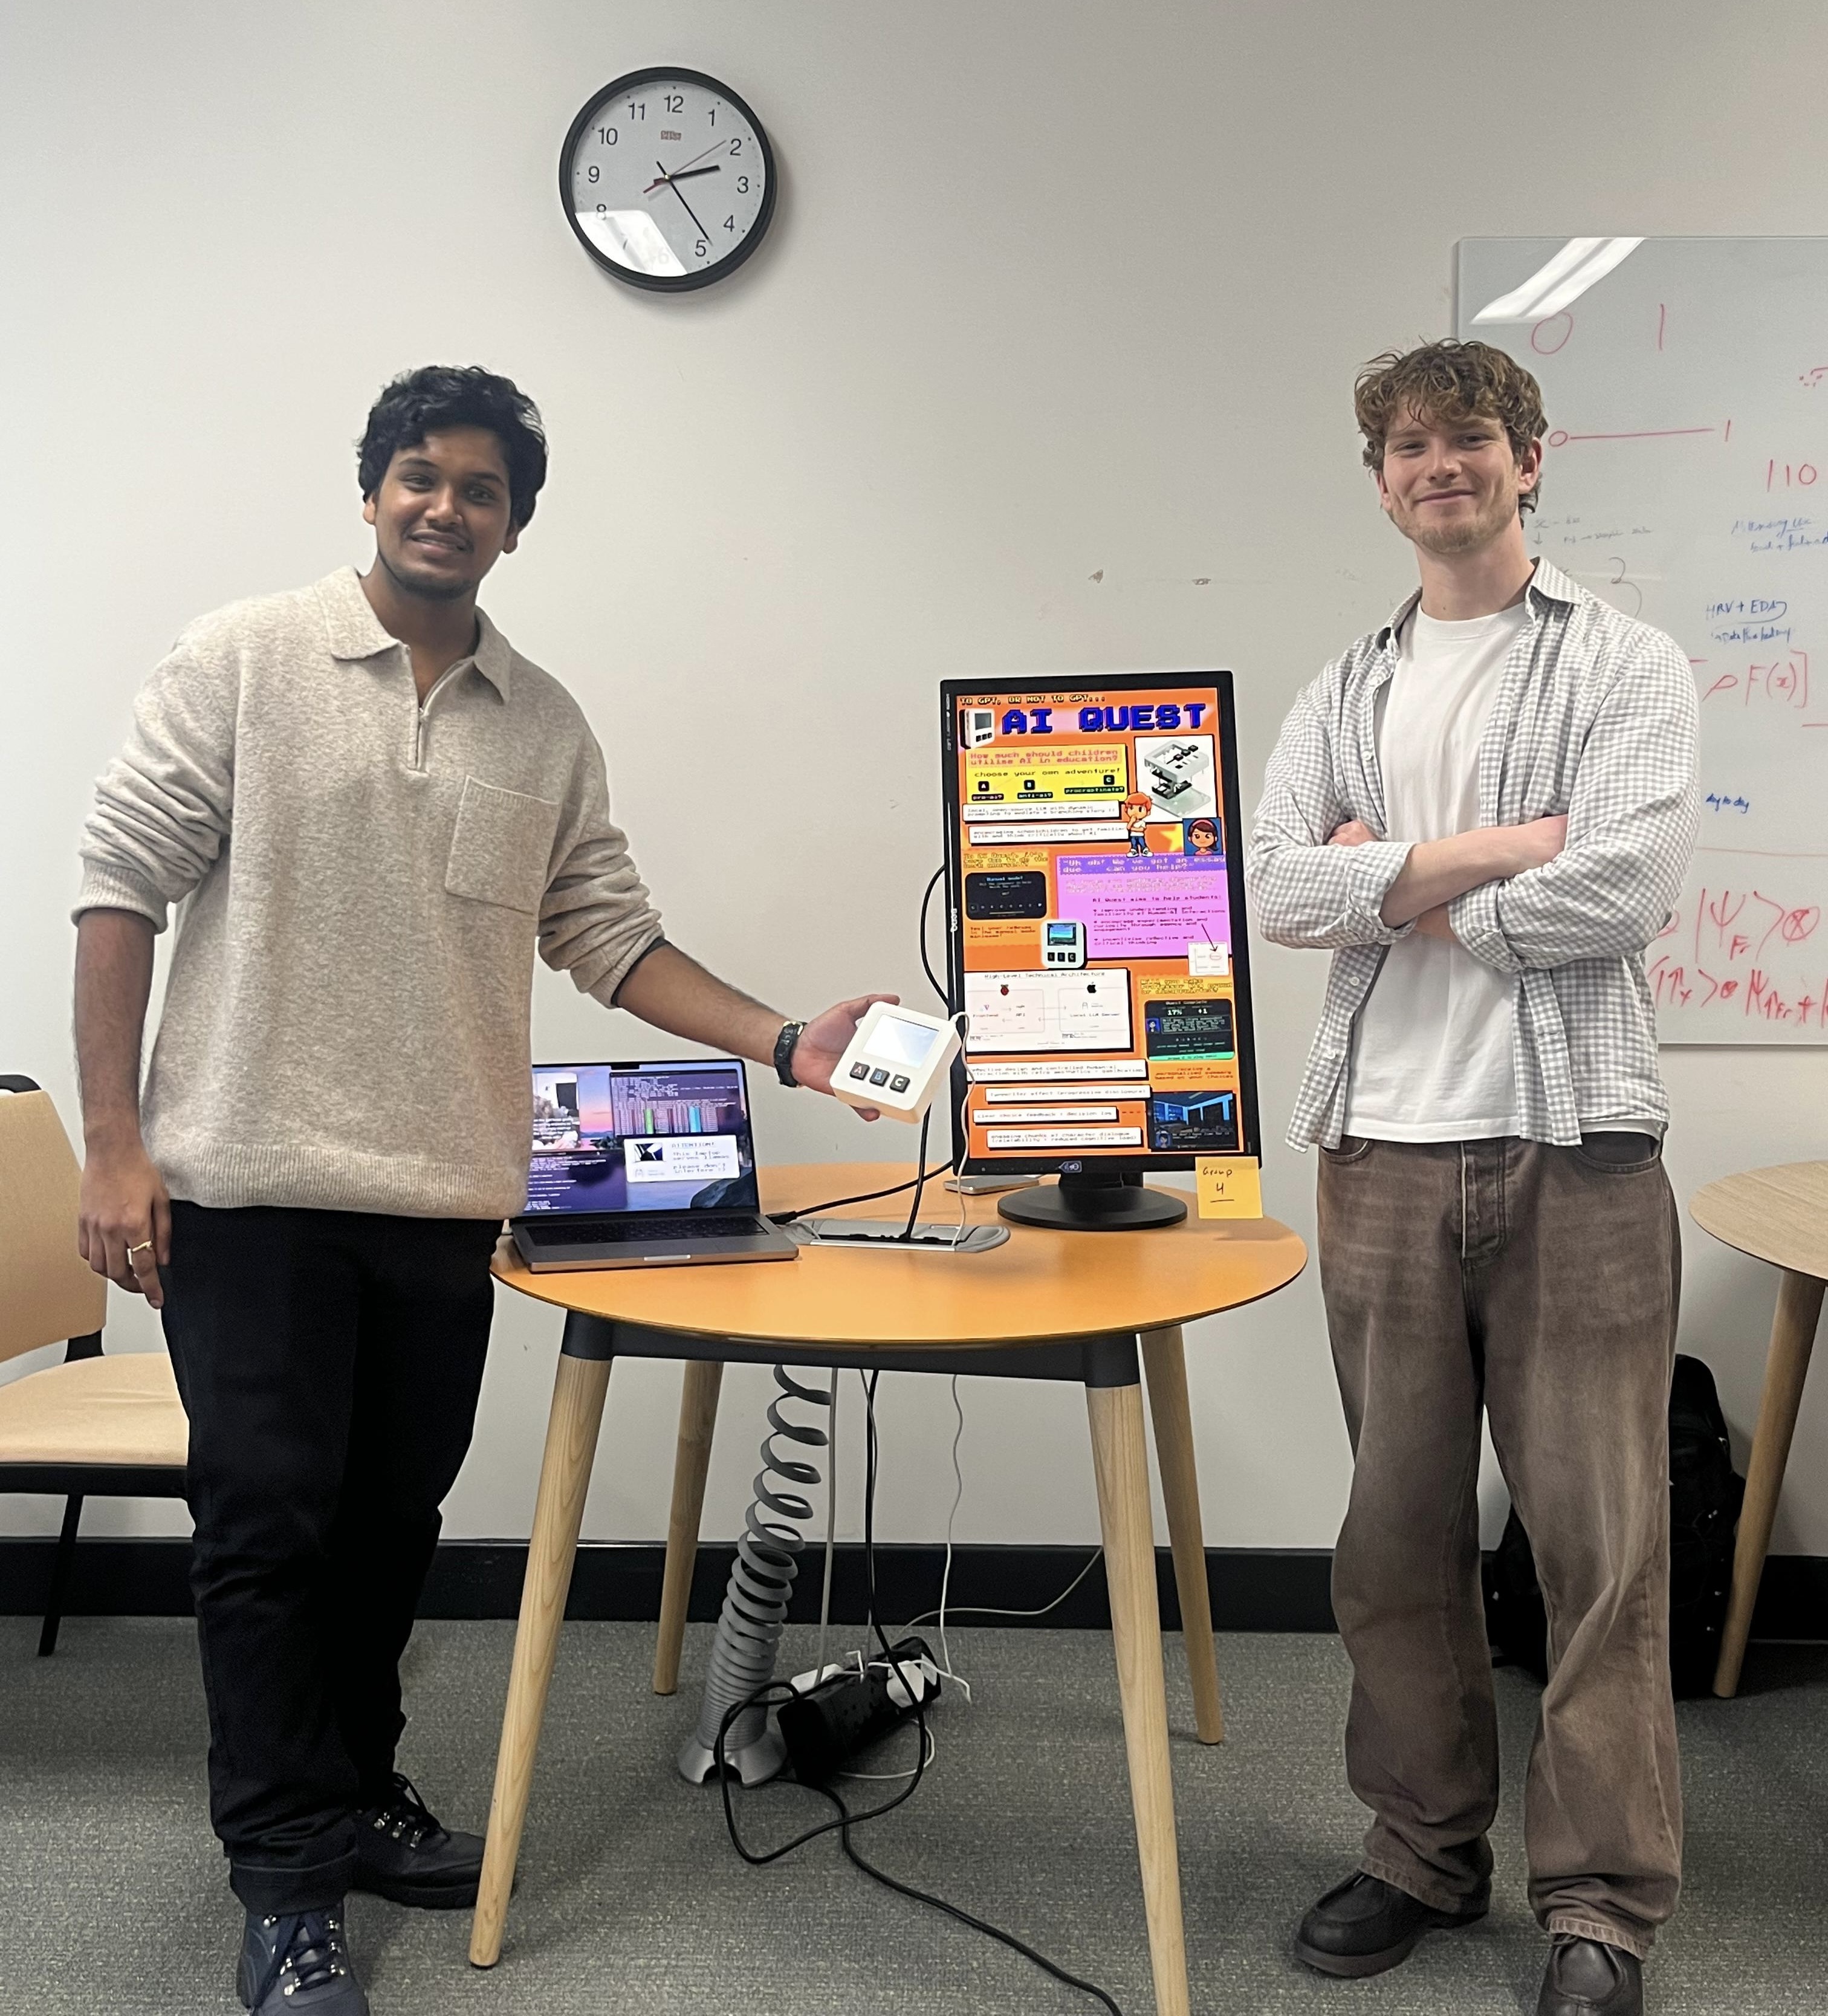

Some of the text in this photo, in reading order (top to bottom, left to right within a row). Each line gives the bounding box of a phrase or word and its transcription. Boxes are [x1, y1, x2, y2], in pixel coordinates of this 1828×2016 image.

[628, 103, 645, 120] 11
[664, 95, 683, 113] 12
[708, 109, 715, 126] 1
[598, 128, 618, 145] 10
[730, 139, 742, 156] 2
[588, 166, 600, 183] 9
[737, 177, 748, 193] 3
[597, 204, 606, 220] 8
[724, 215, 734, 232] 4
[695, 240, 706, 256] 5
[1002, 703, 1206, 734] AI QUEST
[854, 1066, 861, 1074] A
[874, 1072, 882, 1080] B
[894, 1078, 904, 1087] C
[1203, 1167, 1233, 1178] Group
[1216, 1182, 1224, 1194] 4
